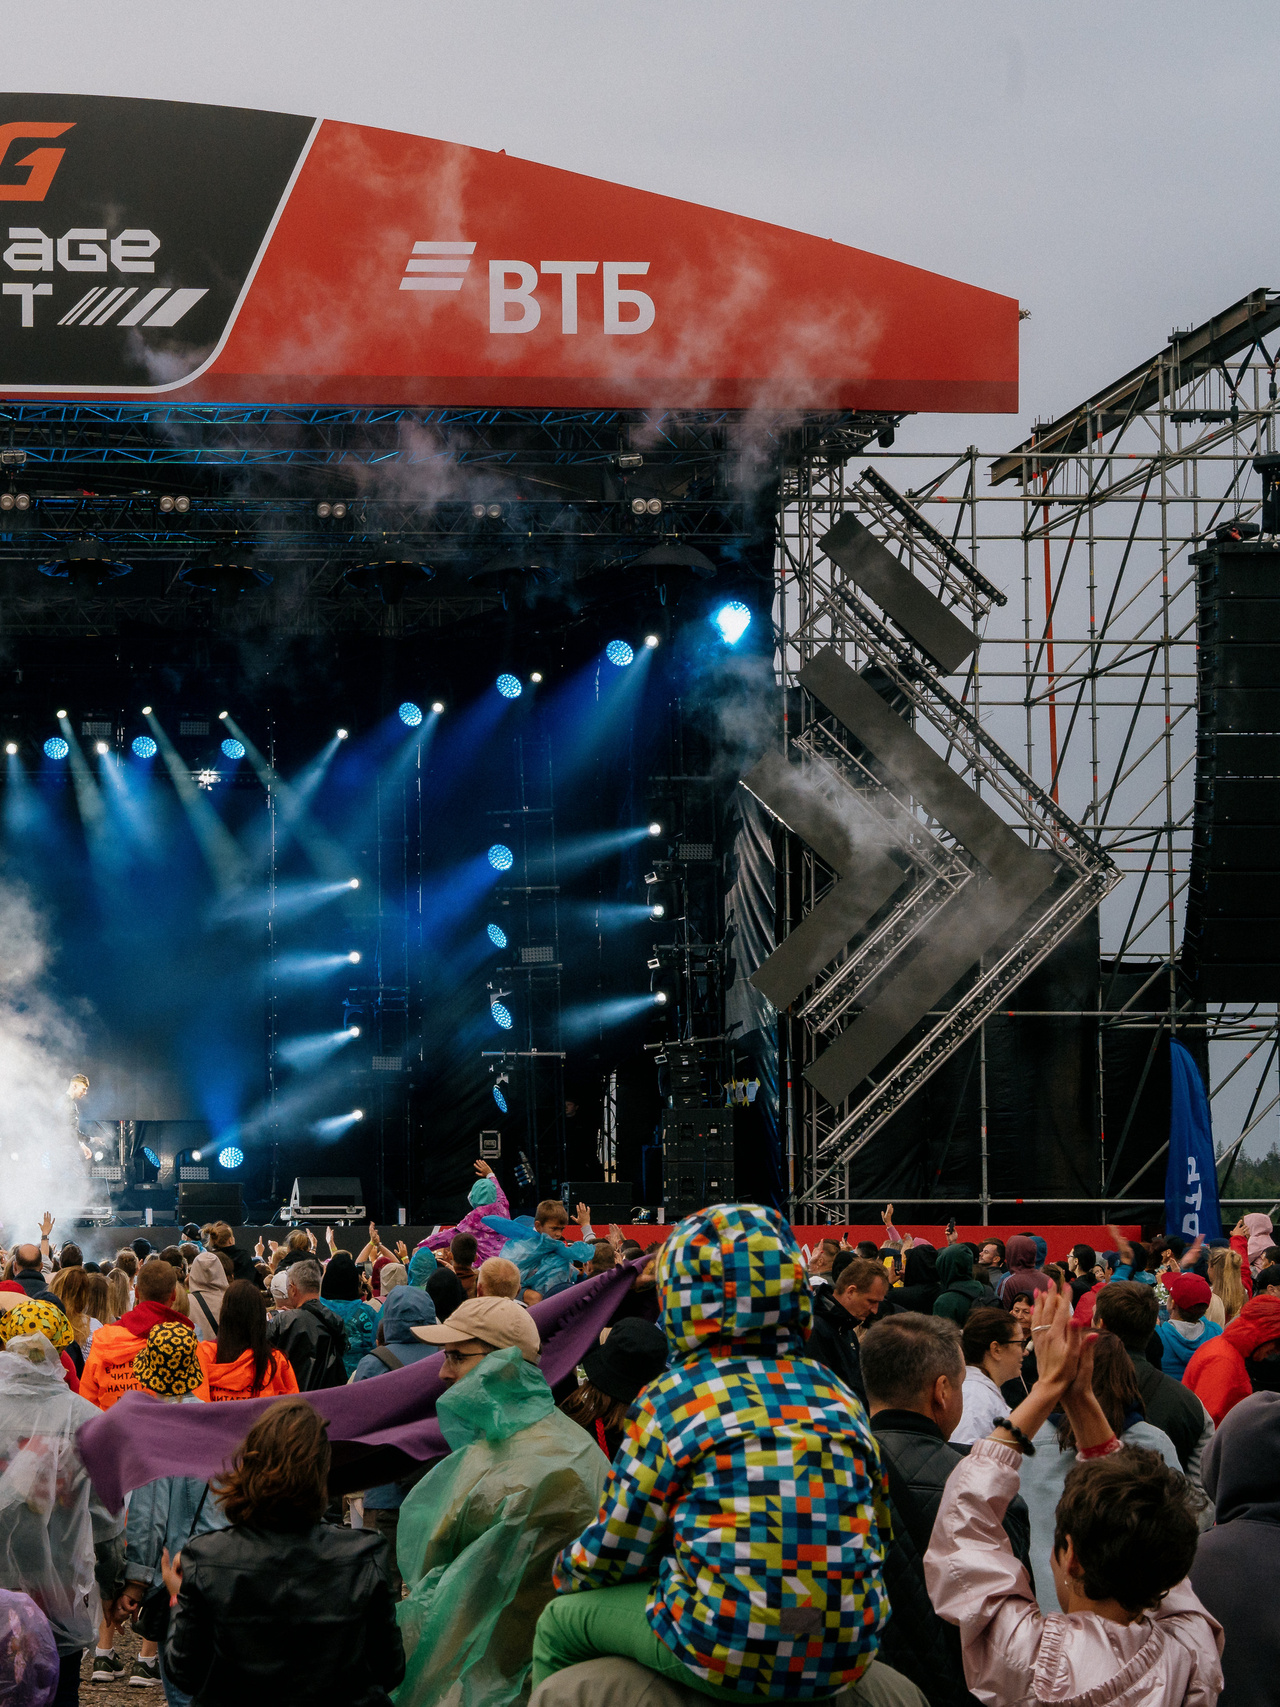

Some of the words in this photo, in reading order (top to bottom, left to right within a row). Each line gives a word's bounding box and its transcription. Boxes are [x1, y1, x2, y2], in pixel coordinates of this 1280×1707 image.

[489, 260, 656, 335] ВТБ
[105, 1362, 125, 1374] ЕЛИ
[106, 1382, 139, 1393] НАЧИТ
